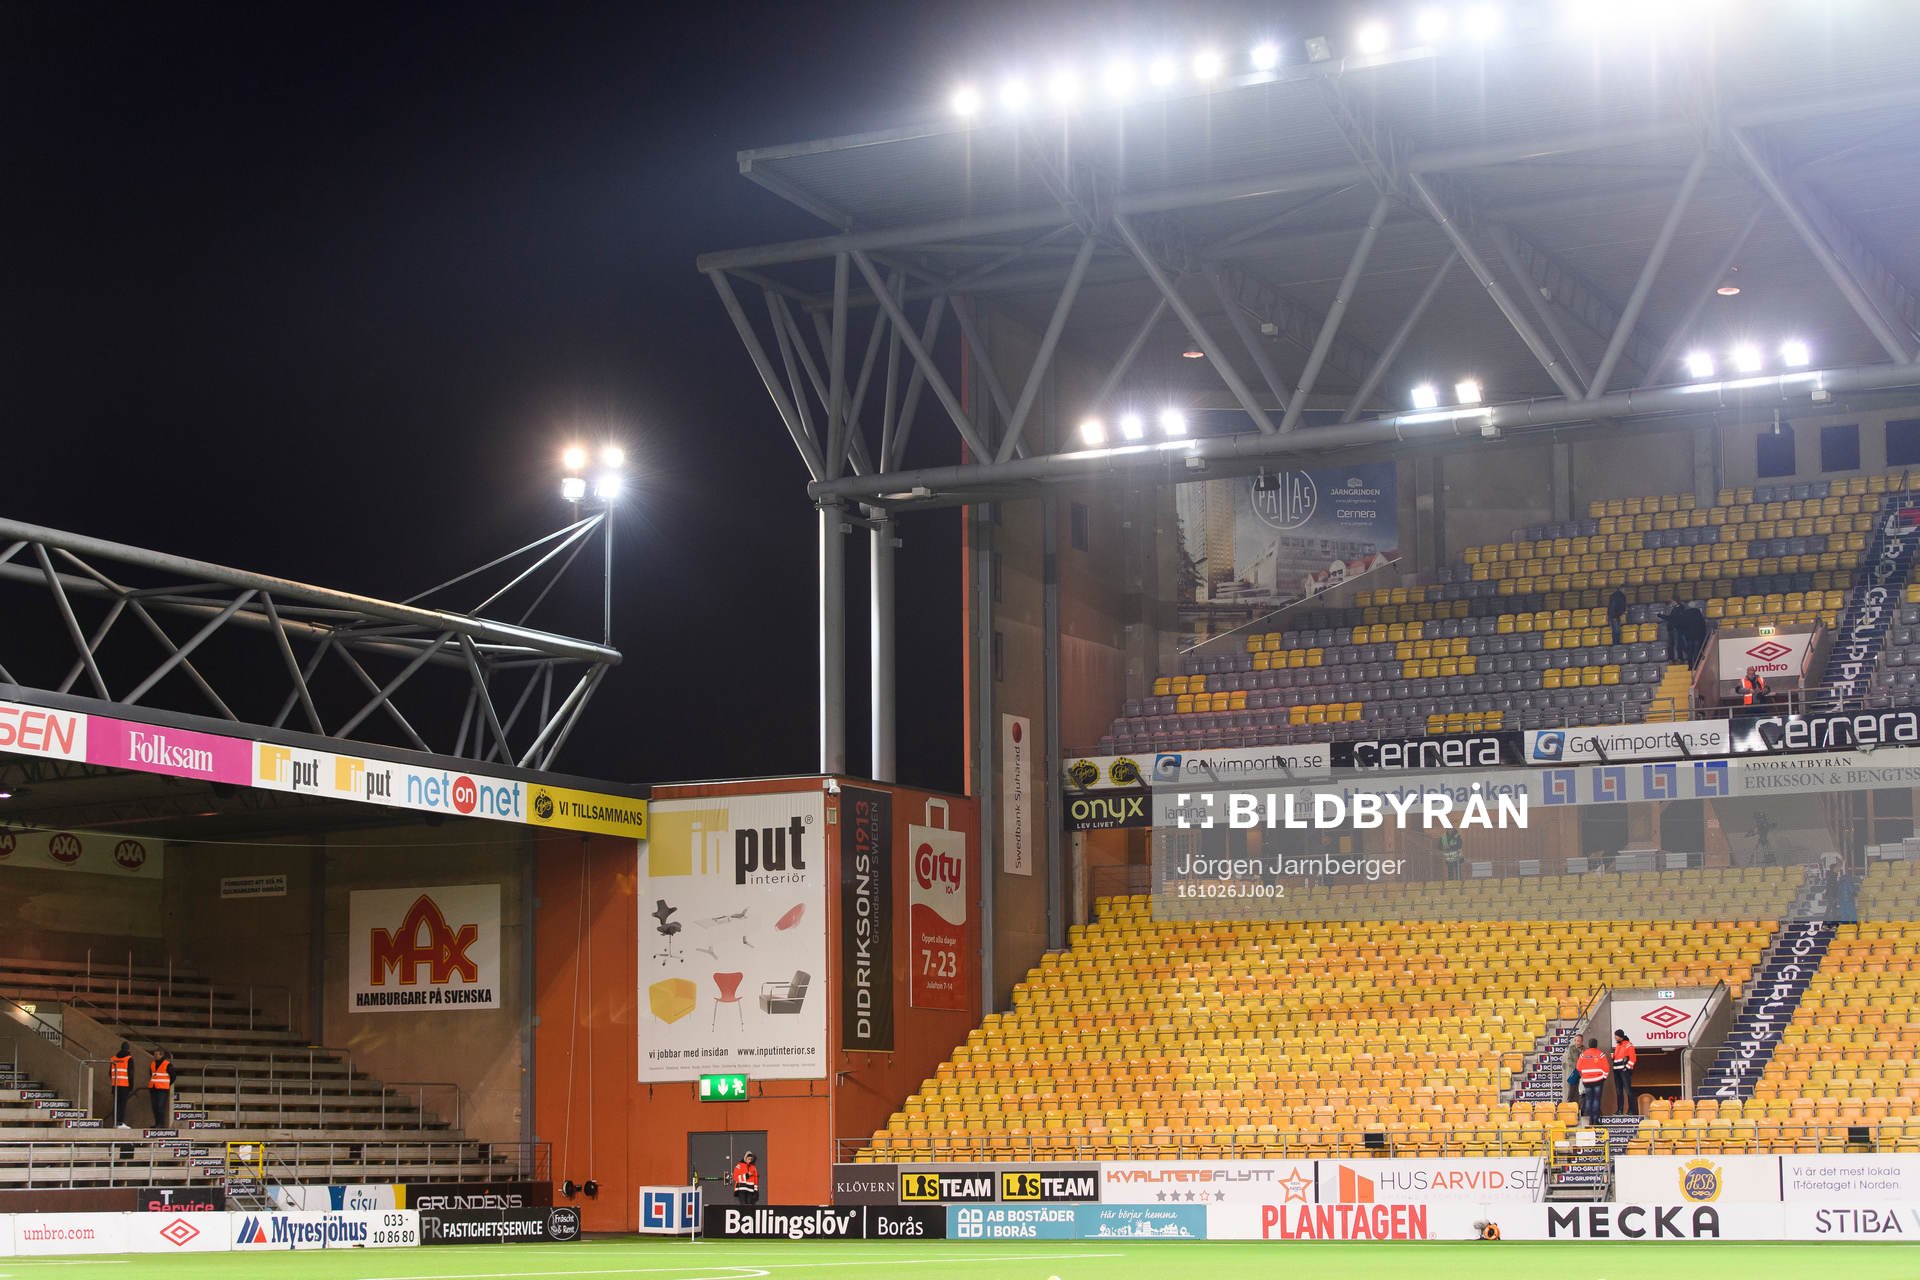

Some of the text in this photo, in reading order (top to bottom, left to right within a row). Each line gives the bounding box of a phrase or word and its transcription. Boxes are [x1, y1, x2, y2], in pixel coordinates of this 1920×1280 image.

[128, 731, 213, 772] Folksam
[1744, 757, 1852, 771] ADVOKATBYRÅN
[1744, 773, 1825, 790] ERIKSSON
[1830, 772, 1842, 784] &
[559, 801, 569, 815] VI
[573, 803, 643, 826] TILLSAMMANS
[1071, 797, 1144, 825] onyx
[872, 802, 880, 864] SWEDEN
[915, 843, 961, 891] City
[751, 873, 807, 885] interiör
[371, 894, 478, 986] MAX
[922, 949, 957, 978] 7-23
[356, 987, 492, 1006] HAMBURGARE PÅ SVENSKA
[1646, 1030, 1687, 1040] umbro
[649, 1045, 816, 1060] vi jobbar med insidan www.inputinterior.se
[1107, 1169, 1275, 1183] KVALITETSFLYTT
[1793, 1166, 1901, 1176] Vi är det mest lokala
[837, 1178, 895, 1193] KLÖVERN
[1380, 1170, 1539, 1191] HUSARVID.SE
[417, 1195, 523, 1211] GRUNDENS
[987, 1208, 1075, 1222] AB BOSTÄDER
[1100, 1209, 1178, 1222] Här börjar hemma
[1262, 1204, 1427, 1240] PLANTAGEN
[1547, 1205, 1720, 1238] MECKA
[1815, 1209, 1903, 1233] STIBA
[24, 1224, 95, 1240] umbro.com
[272, 1215, 368, 1249] Myresjöhus
[443, 1221, 543, 1239] FASTIGHETSSERVICE
[878, 1215, 923, 1236] Borås
[986, 1224, 1037, 1237] I BORÅS
[373, 1230, 386, 1244] 10
[401, 1229, 415, 1243] 80
